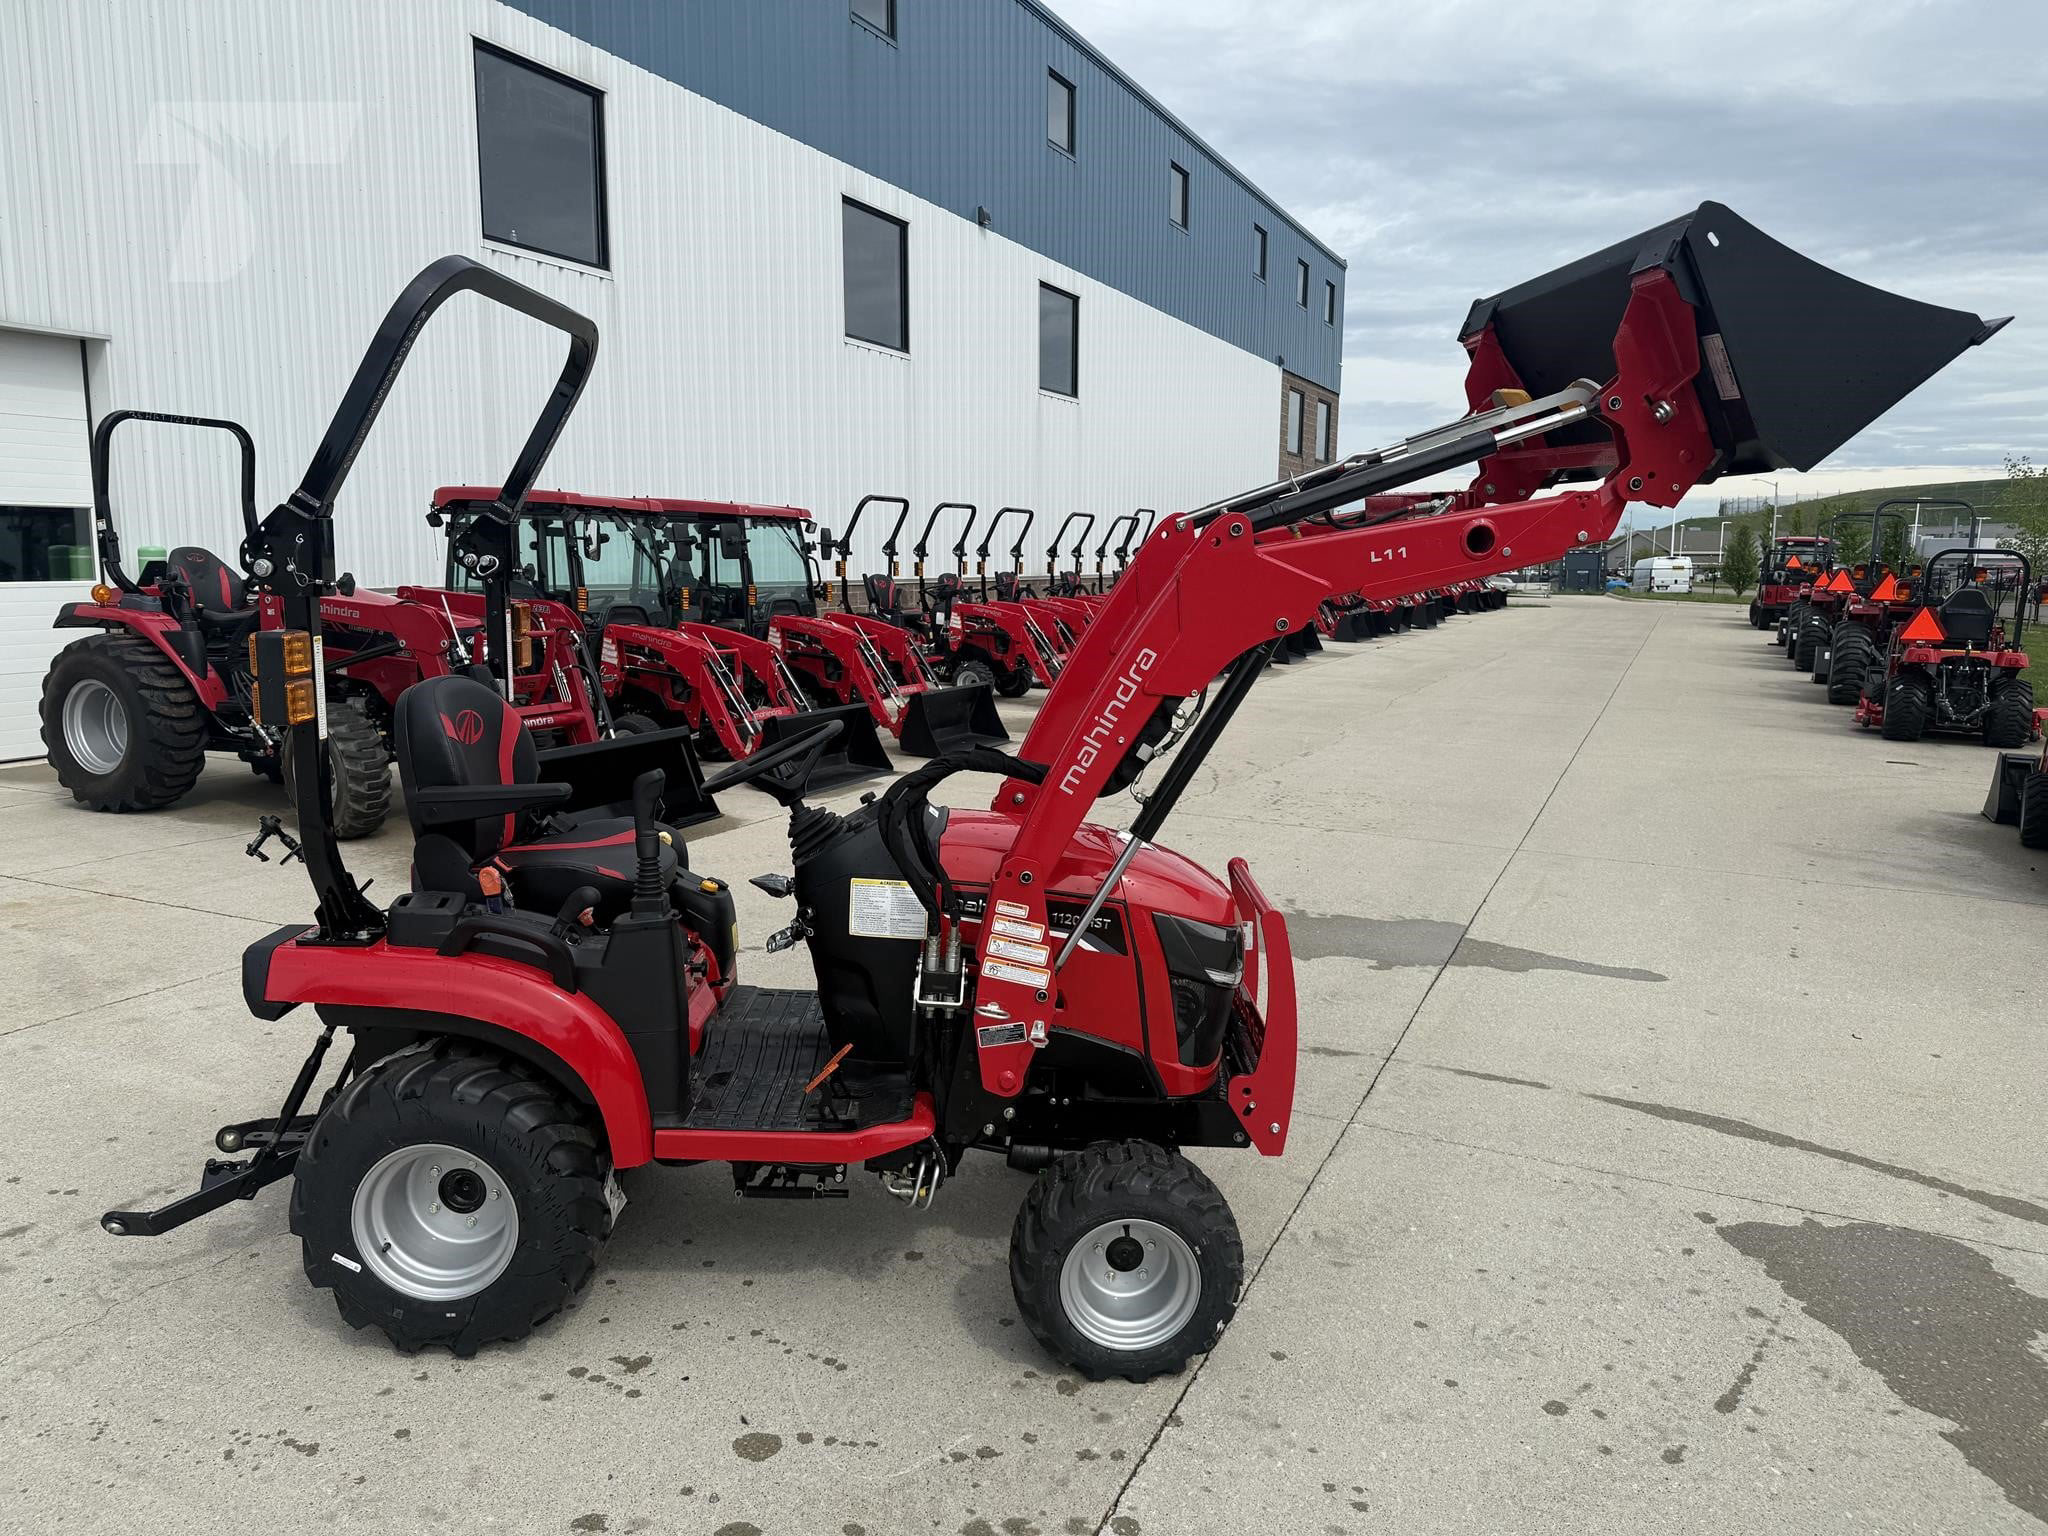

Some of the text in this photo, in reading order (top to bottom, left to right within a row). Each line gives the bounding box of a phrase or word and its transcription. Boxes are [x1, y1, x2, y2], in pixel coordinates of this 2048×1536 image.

[1370, 546, 1407, 563] L11
[632, 631, 673, 648] mahindra
[1058, 647, 1158, 796] mahindra
